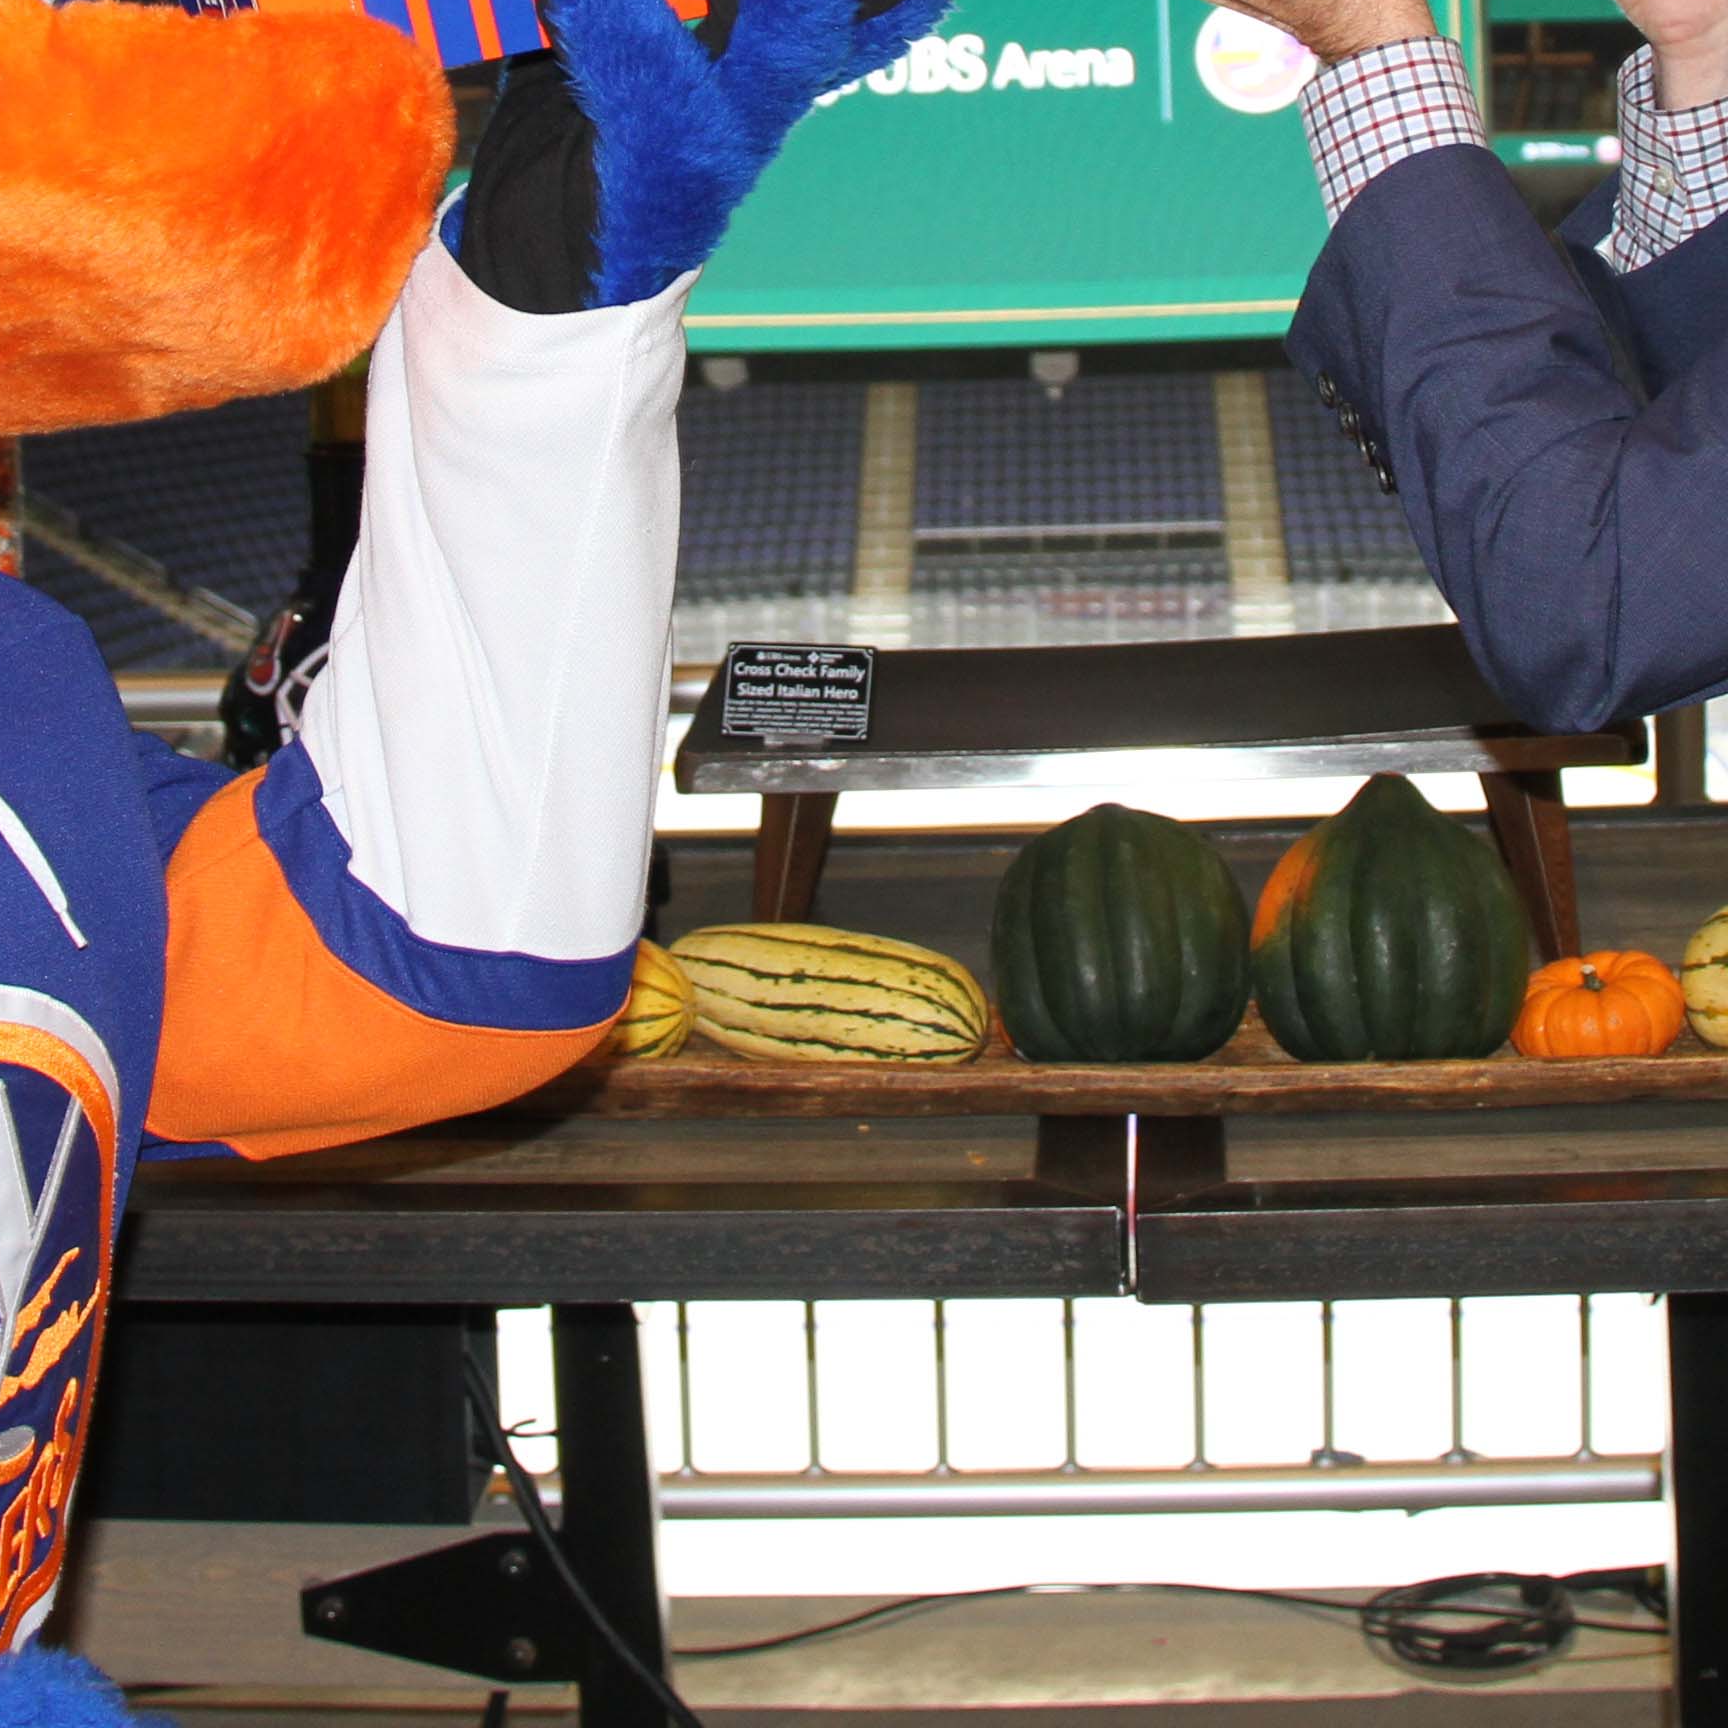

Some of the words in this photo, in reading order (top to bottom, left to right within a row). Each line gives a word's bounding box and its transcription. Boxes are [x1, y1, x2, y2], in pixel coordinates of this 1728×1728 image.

[992, 42, 1135, 90] Arena
[734, 662, 771, 677] Cross
[774, 663, 817, 678] Check
[820, 665, 866, 683] Family
[737, 682, 774, 697] Sized
[777, 683, 820, 699] Italian
[824, 686, 859, 700] Hero
